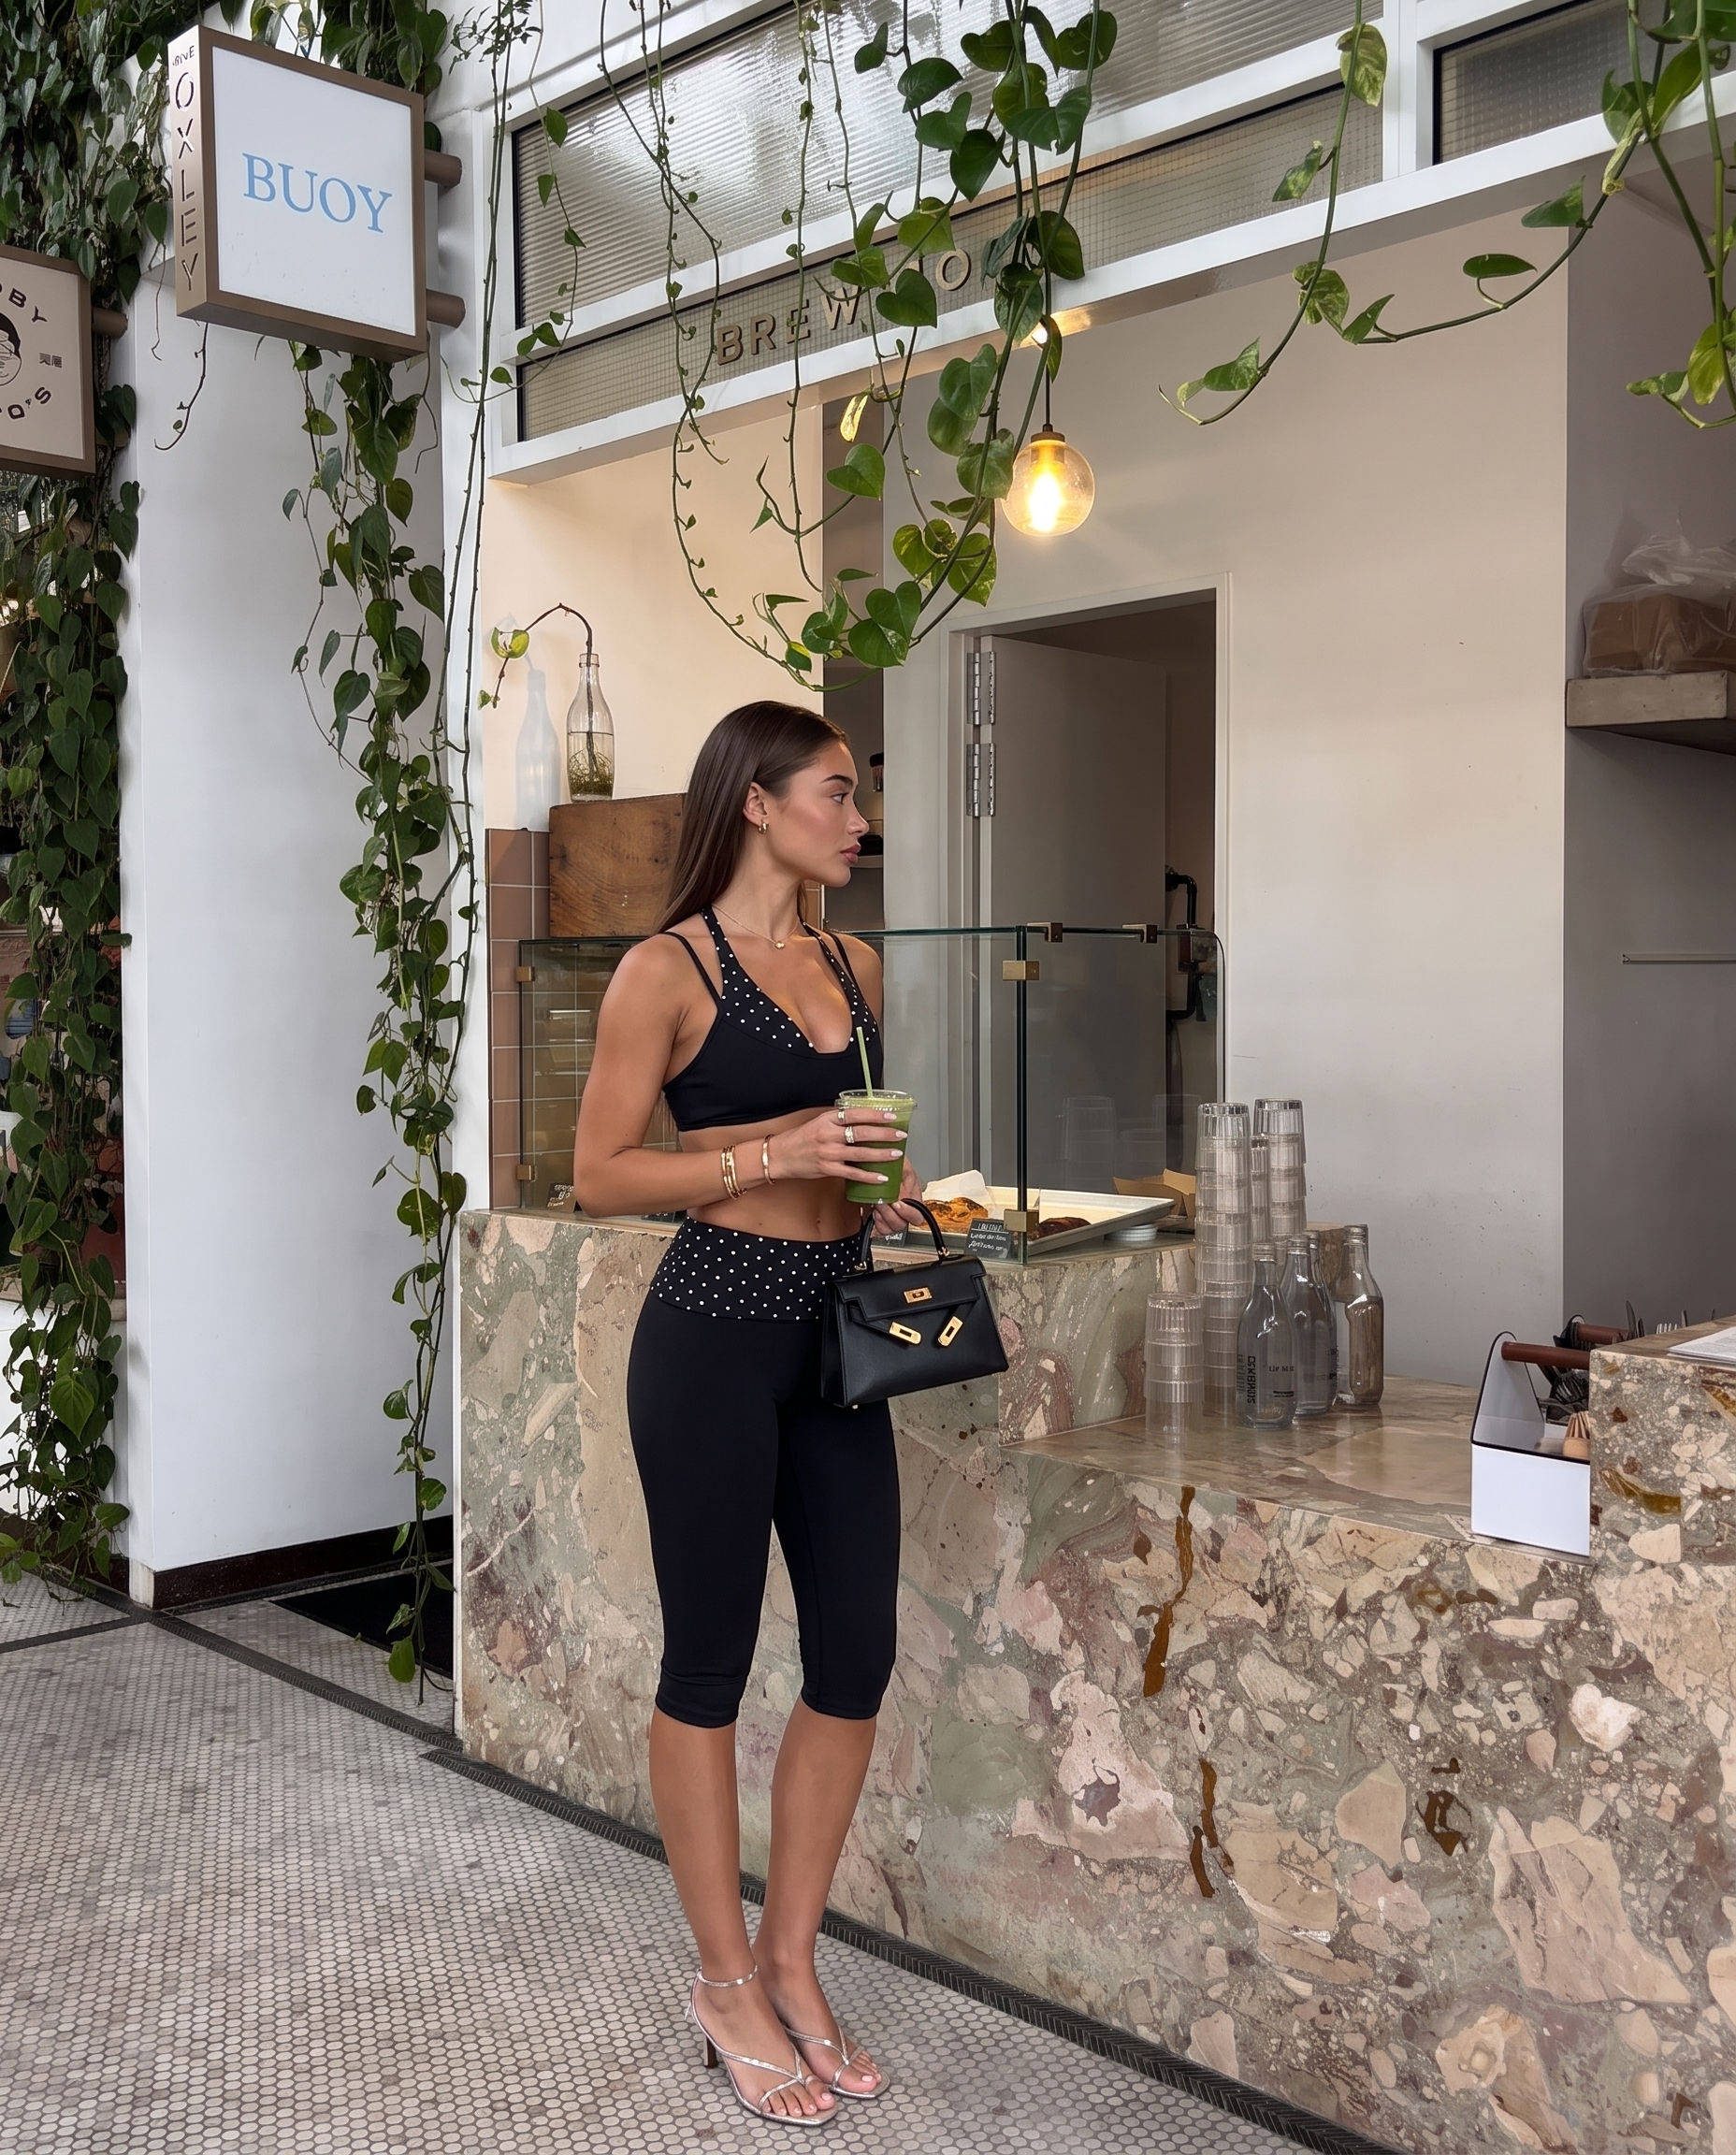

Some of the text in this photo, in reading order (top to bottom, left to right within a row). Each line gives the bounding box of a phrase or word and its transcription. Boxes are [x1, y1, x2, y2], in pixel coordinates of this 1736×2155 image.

[175, 72, 198, 291] OXLEY
[242, 152, 392, 233] BUOY
[0, 282, 48, 323] BY
[716, 284, 861, 366] BREW
